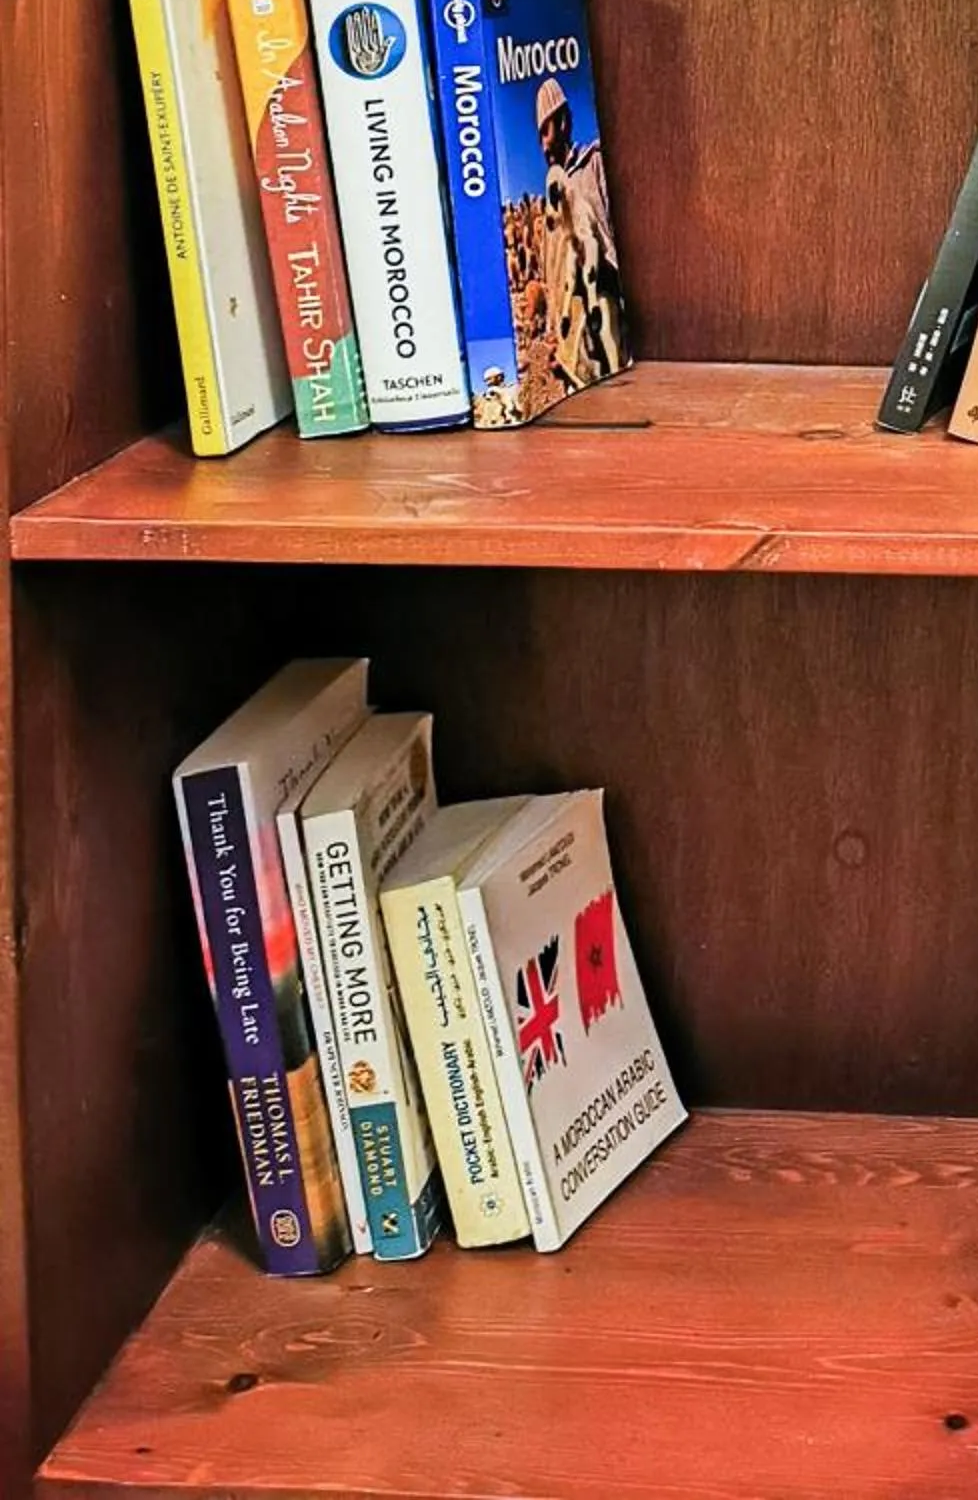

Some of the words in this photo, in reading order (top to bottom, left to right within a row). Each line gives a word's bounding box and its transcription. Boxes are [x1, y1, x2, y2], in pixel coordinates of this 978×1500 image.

[496, 36, 579, 84] Morocco
[364, 98, 395, 181] LIVING
[451, 66, 486, 197] Morocco
[167, 174, 177, 192] DE
[376, 184, 397, 216] IN
[169, 194, 187, 260] ANTOINE
[287, 244, 324, 331] TAHIR
[381, 225, 417, 361] MOROCCO
[195, 377, 211, 434] Gallimard
[303, 337, 335, 423] SHAH
[383, 374, 443, 390] TASCHEN
[206, 793, 235, 858] Thank
[219, 863, 238, 903] You
[226, 906, 244, 935] for
[326, 842, 363, 959] GETTING
[346, 967, 377, 1045] MORE
[231, 942, 254, 1002] Being
[239, 1004, 259, 1045] Late
[262, 1070, 292, 1163] THOMAS
[441, 1042, 473, 1126] DICTIONARY
[553, 1144, 562, 1166] A
[561, 1085, 617, 1156] MOROCCAN
[616, 1049, 655, 1097] ARABIC
[240, 1076, 274, 1185] FRIEDMAN
[360, 1121, 383, 1197] DIAMOND
[377, 1124, 398, 1188] STUART
[461, 1131, 485, 1185] POCKET
[561, 1111, 637, 1201] CONVERSATION
[634, 1081, 667, 1124] GUIDE
